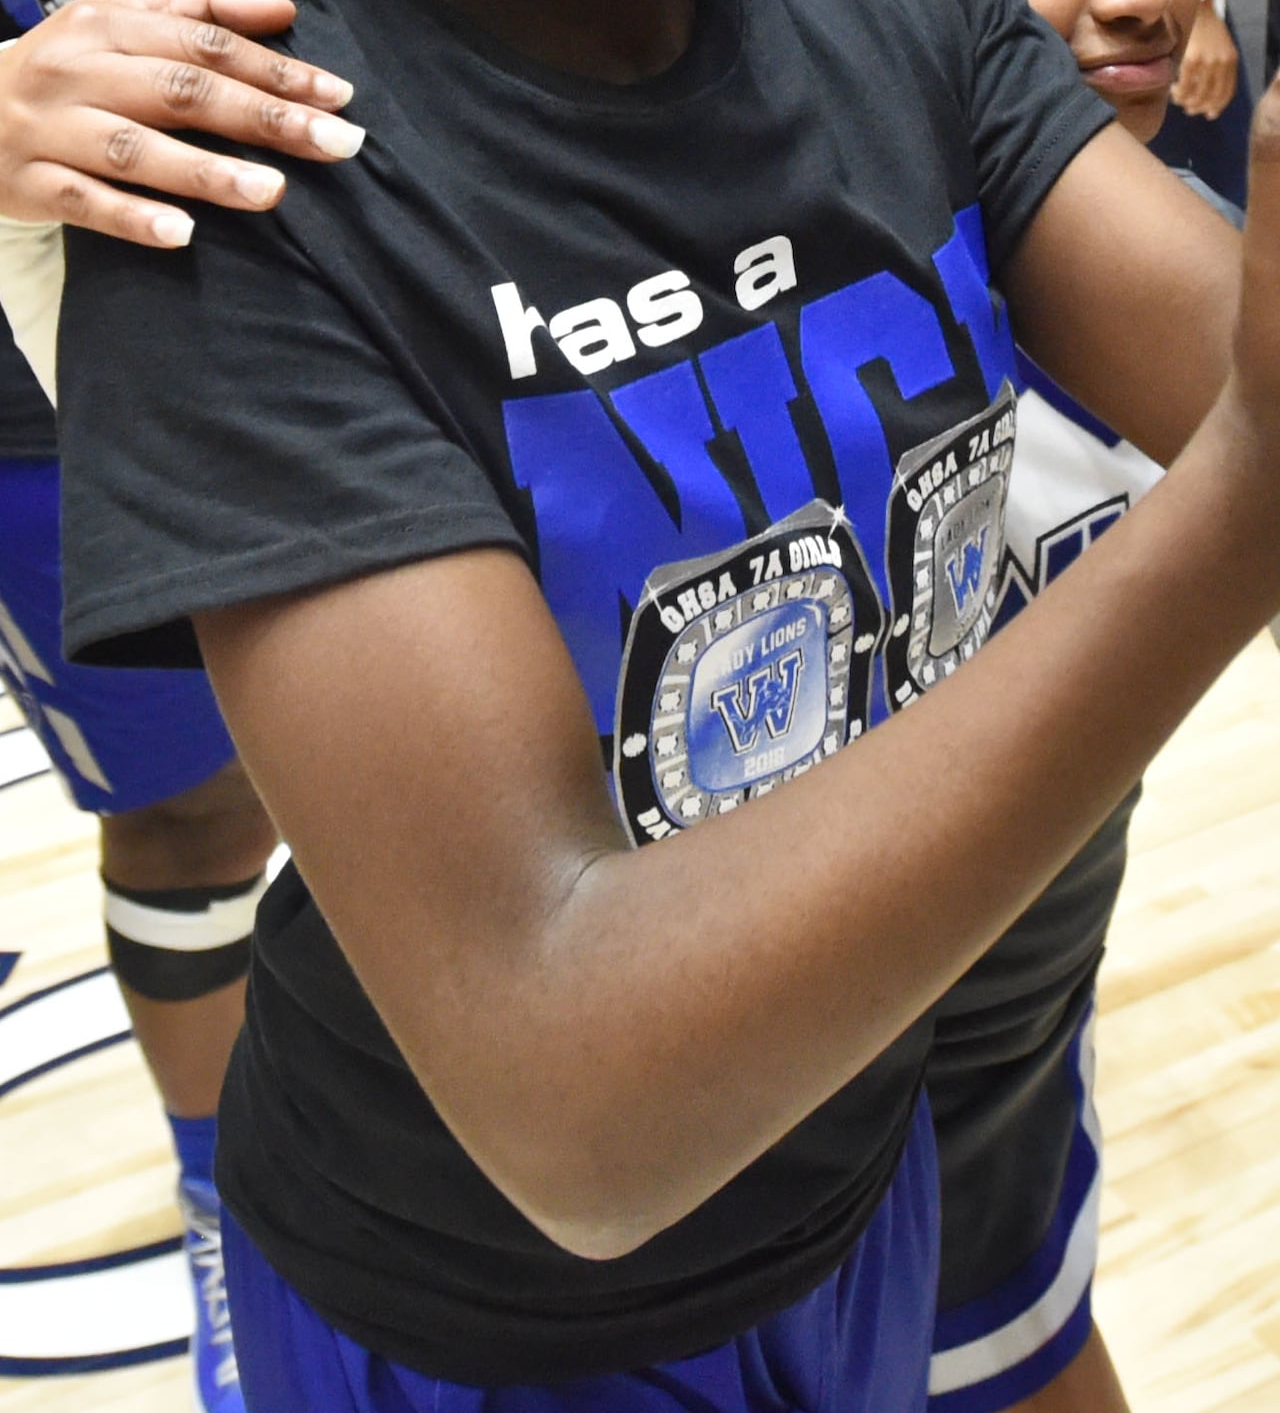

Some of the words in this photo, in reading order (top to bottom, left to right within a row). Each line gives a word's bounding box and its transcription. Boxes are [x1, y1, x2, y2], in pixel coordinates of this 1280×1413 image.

[491, 269, 705, 379] has
[733, 234, 799, 312] a
[749, 549, 784, 586] 7A
[761, 616, 807, 658] LIONS
[710, 648, 804, 756] W
